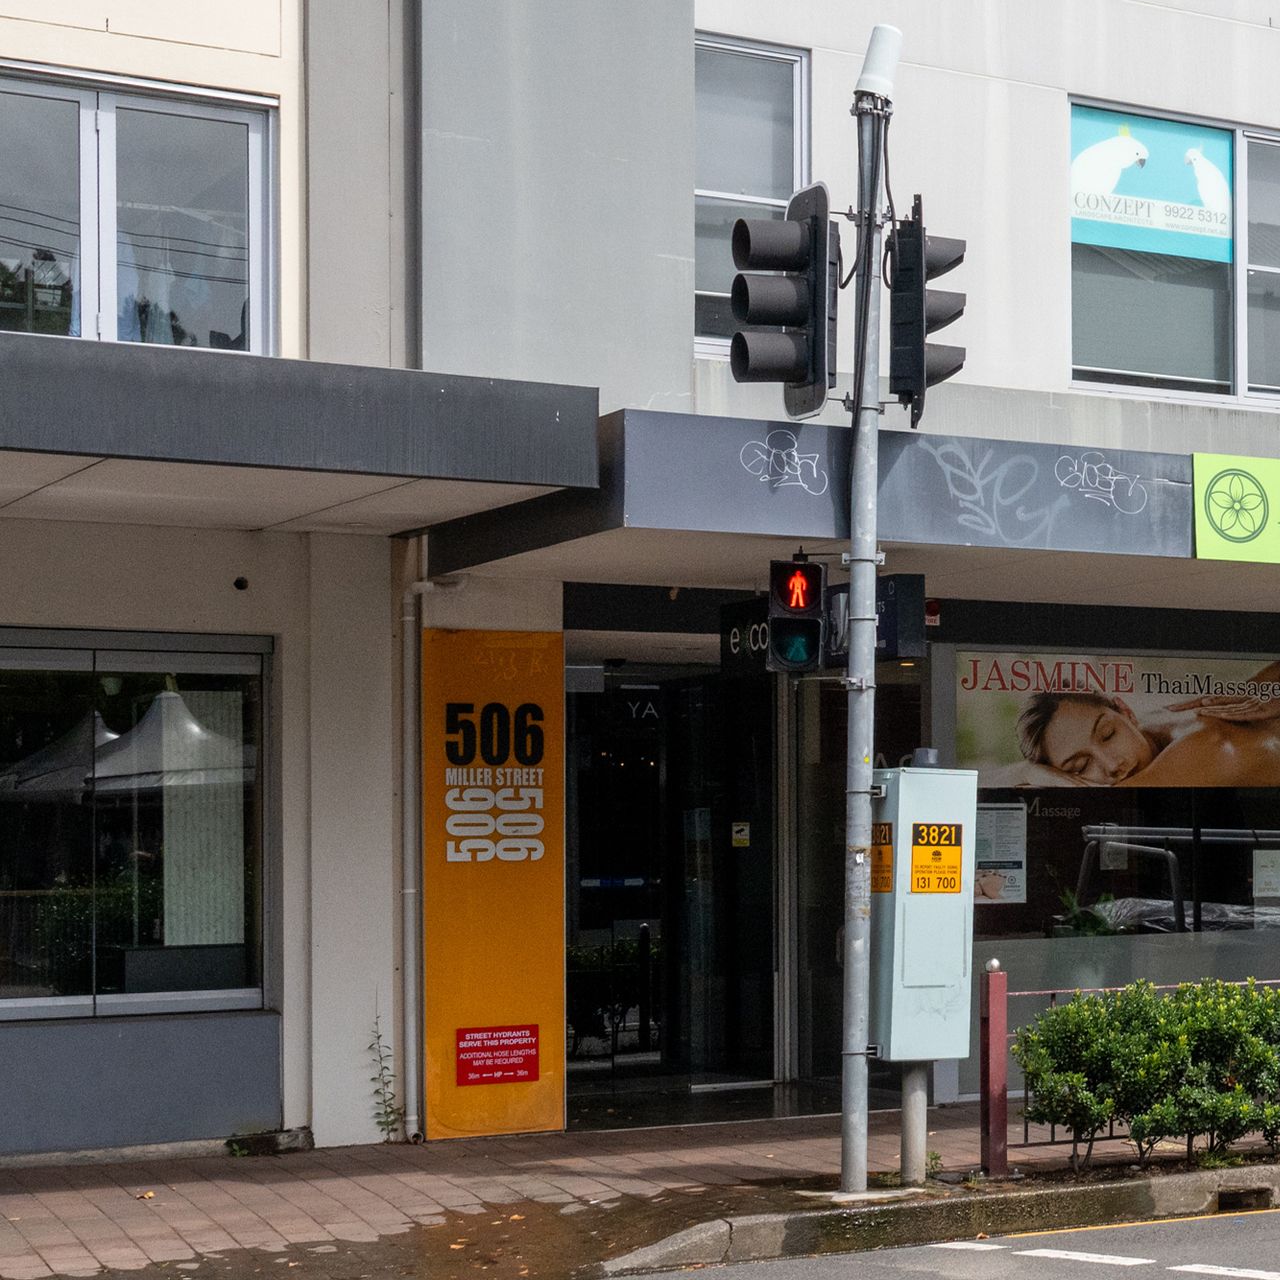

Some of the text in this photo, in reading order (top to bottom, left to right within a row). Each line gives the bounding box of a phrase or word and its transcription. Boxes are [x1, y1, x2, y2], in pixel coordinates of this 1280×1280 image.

[1074, 191, 1227, 225] CONZEPT 9922 5312
[961, 659, 1134, 695] JASMINE
[445, 703, 544, 766] 506
[445, 768, 544, 786] MILLER STREET
[918, 825, 956, 845] 3821
[916, 877, 956, 889] 131 700
[459, 1040, 482, 1048] SERVE
[500, 1037, 536, 1045] PROPERTY
[465, 1030, 530, 1040] STREET HYDRANTS
[459, 1051, 493, 1059] ADDITIONAL
